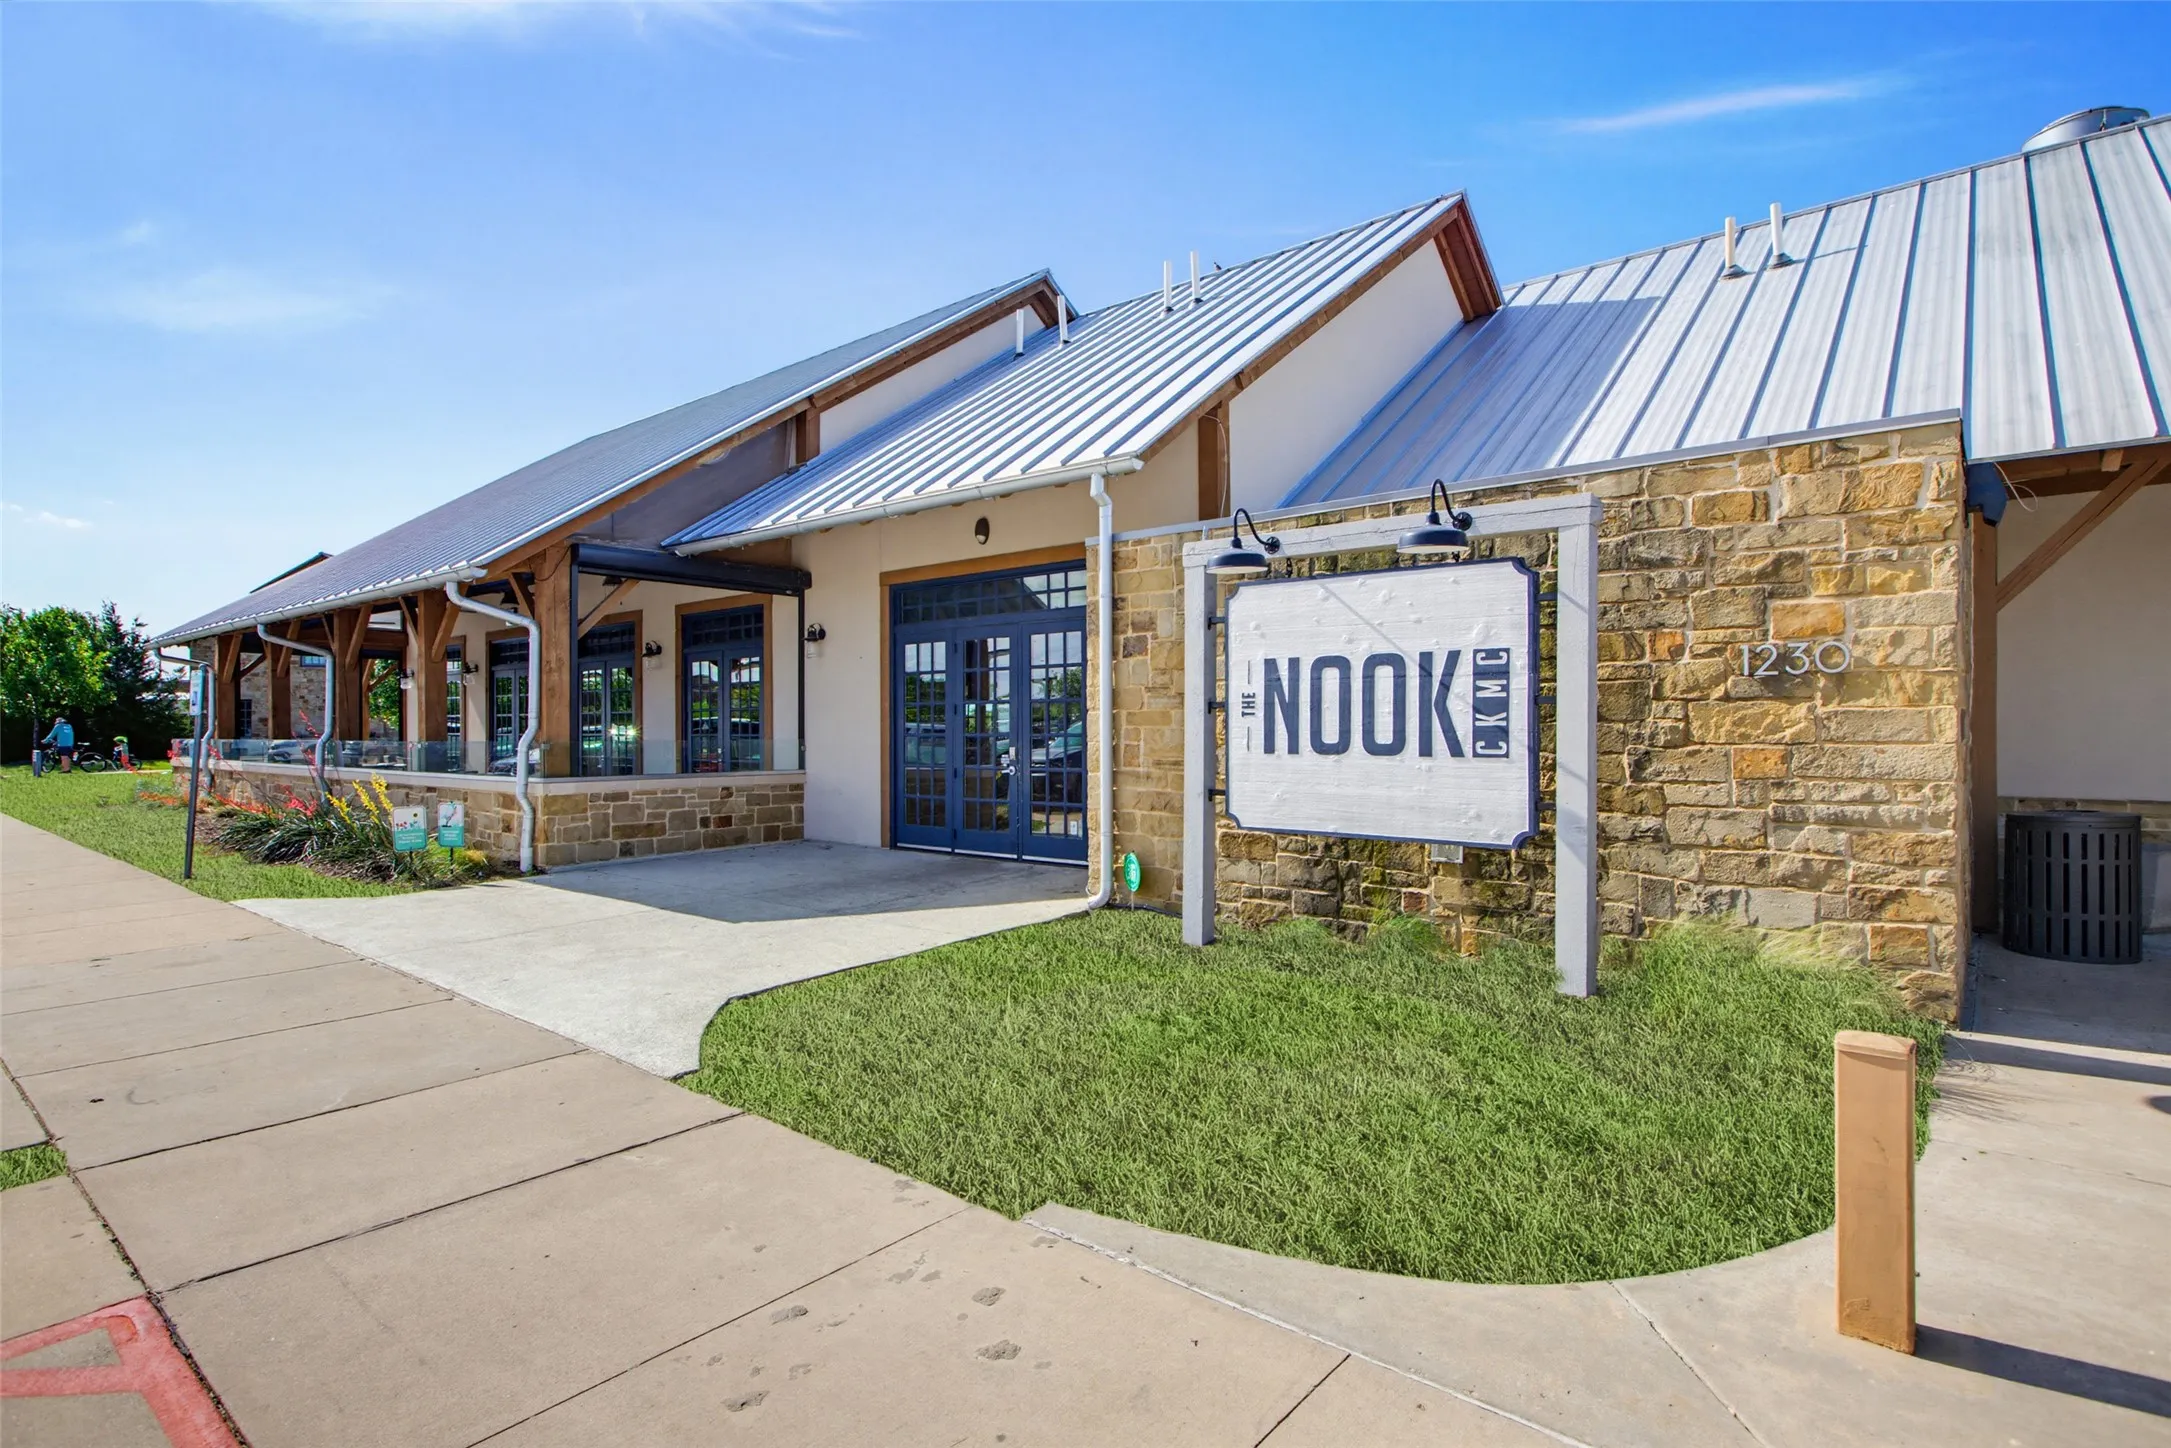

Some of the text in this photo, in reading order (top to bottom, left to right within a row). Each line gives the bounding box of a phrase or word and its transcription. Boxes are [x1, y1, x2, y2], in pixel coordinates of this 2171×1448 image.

[1739, 641, 1850, 676] 1230
[1241, 692, 1256, 718] THE
[1263, 649, 1466, 758] NOOK
[1474, 650, 1508, 755] CKMC
